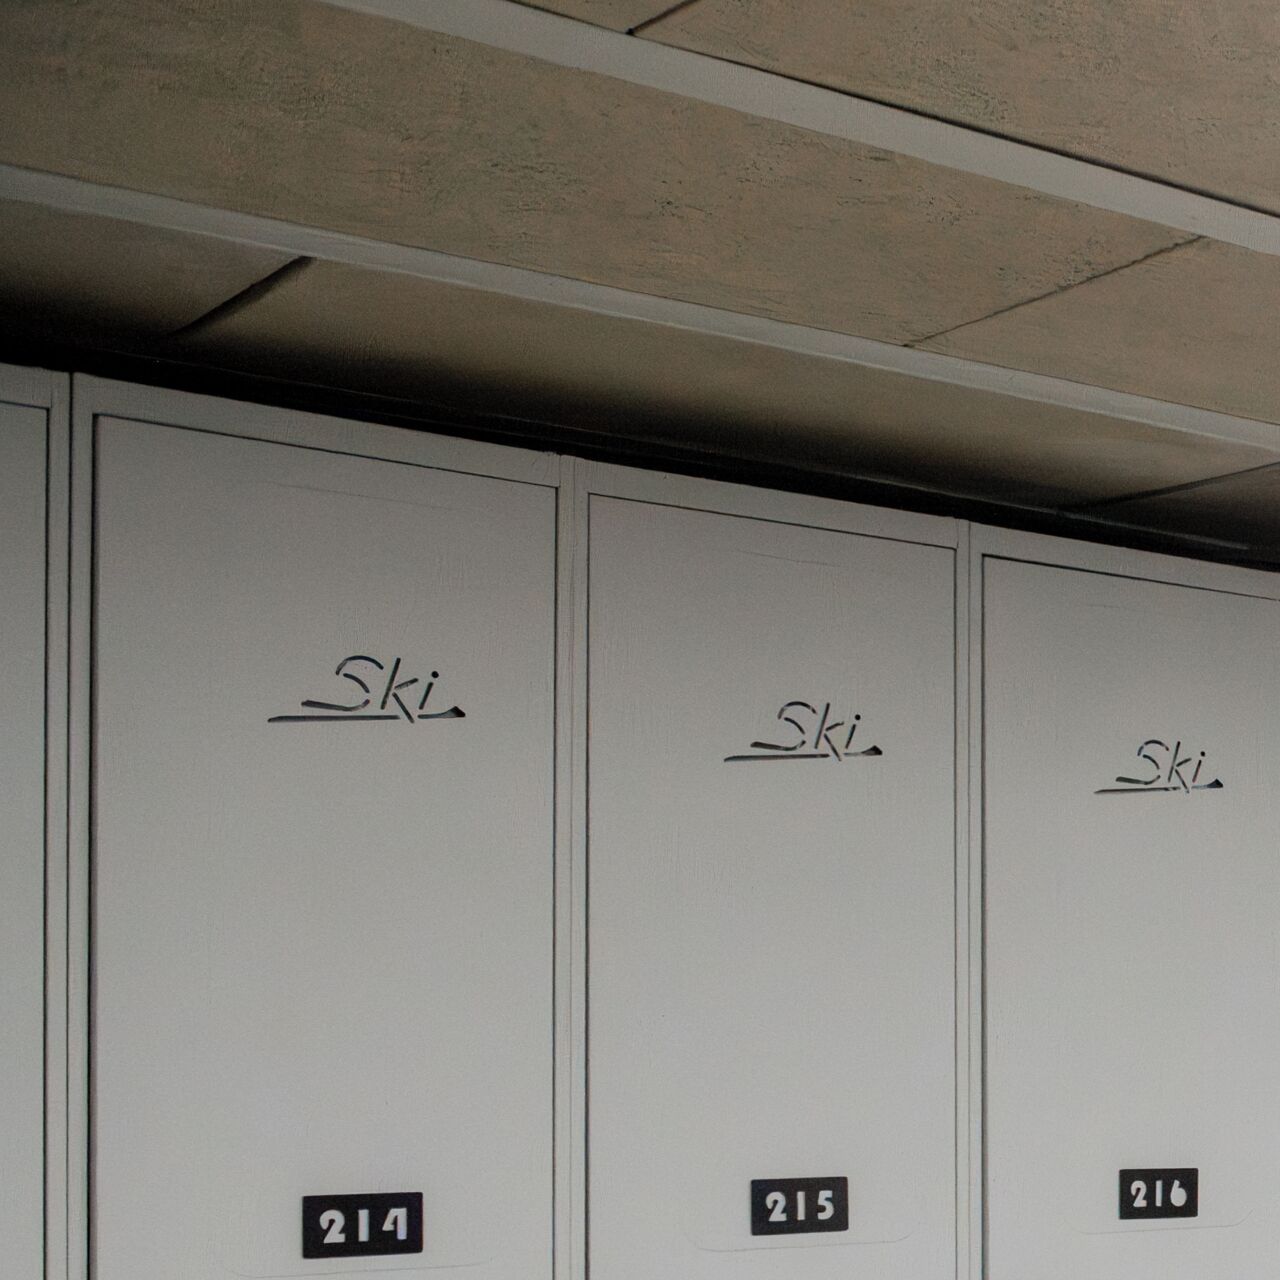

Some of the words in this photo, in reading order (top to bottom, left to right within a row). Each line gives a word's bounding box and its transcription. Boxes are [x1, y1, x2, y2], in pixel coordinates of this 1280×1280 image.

[295, 655, 463, 722] Ski
[747, 701, 880, 761] Ski
[1112, 739, 1222, 792] Ski
[765, 1189, 835, 1222] 215
[1130, 1179, 1188, 1208] 216
[319, 1207, 408, 1244] 214
